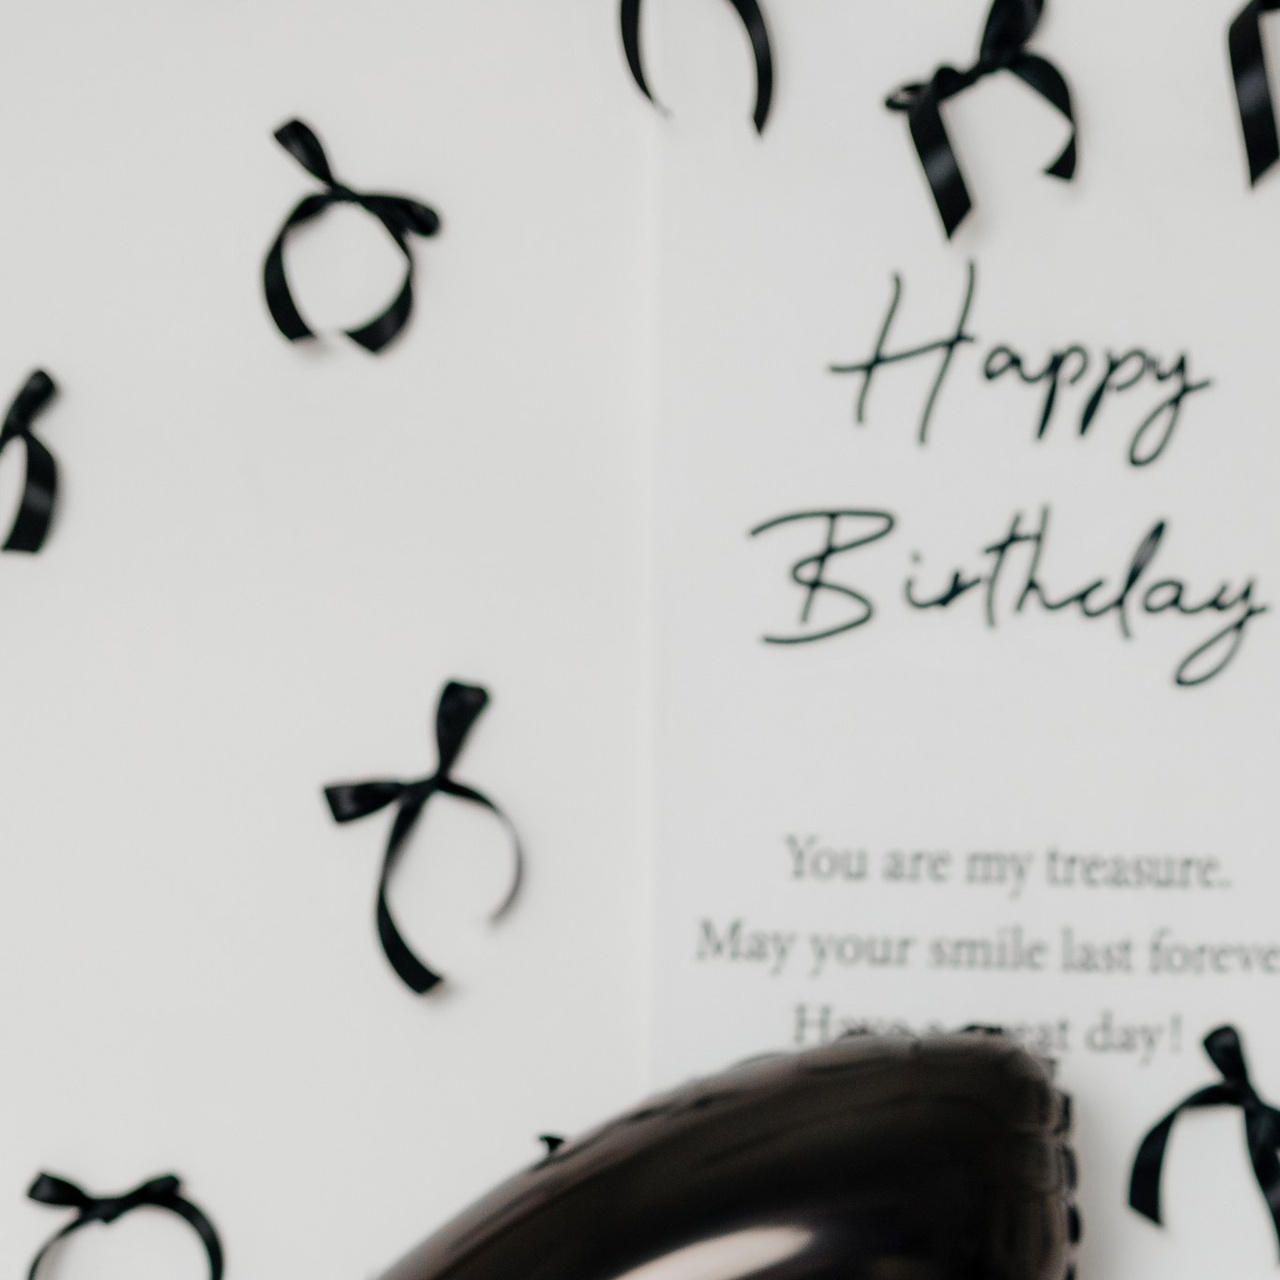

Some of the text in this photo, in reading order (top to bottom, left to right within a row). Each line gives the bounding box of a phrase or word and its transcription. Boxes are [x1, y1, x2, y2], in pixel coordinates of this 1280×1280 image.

[828, 259, 1212, 467] Happy
[748, 505, 1271, 687] Birthday
[783, 834, 1233, 900] You are my treasure.
[696, 917, 796, 977] May
[807, 934, 915, 977] your
[928, 922, 1048, 972] smile
[1060, 925, 1133, 975] last
[1084, 1008, 1183, 1067] day!
